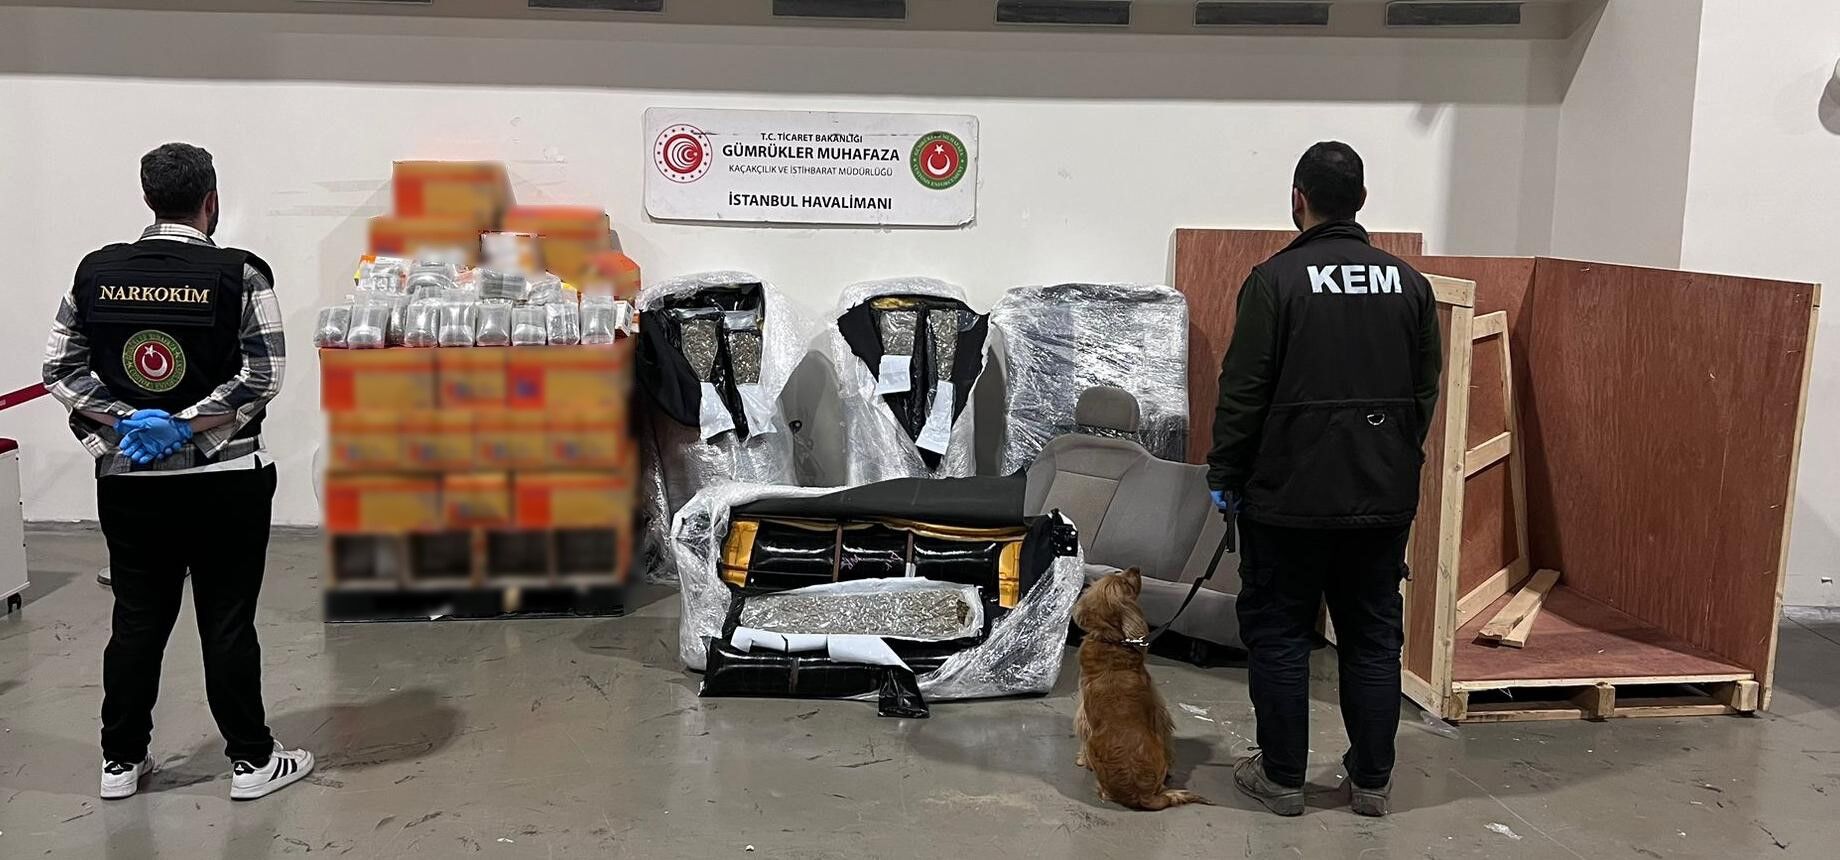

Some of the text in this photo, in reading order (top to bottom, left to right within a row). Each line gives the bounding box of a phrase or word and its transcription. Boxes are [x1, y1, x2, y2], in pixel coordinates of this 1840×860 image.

[760, 132, 863, 143] T.C. TİCARET BAKANLIĞI
[722, 142, 900, 161] GÜMRÜKLER MUHAFAZA
[729, 164, 893, 176] KAÇAKÇILIK VE İSTİHBARAT MÜDÜRLÜĞÜ
[728, 191, 892, 209] İSTANBUL HAVALİMANI
[1306, 264, 1402, 294] KEM
[99, 284, 210, 303] NARKOKİM
